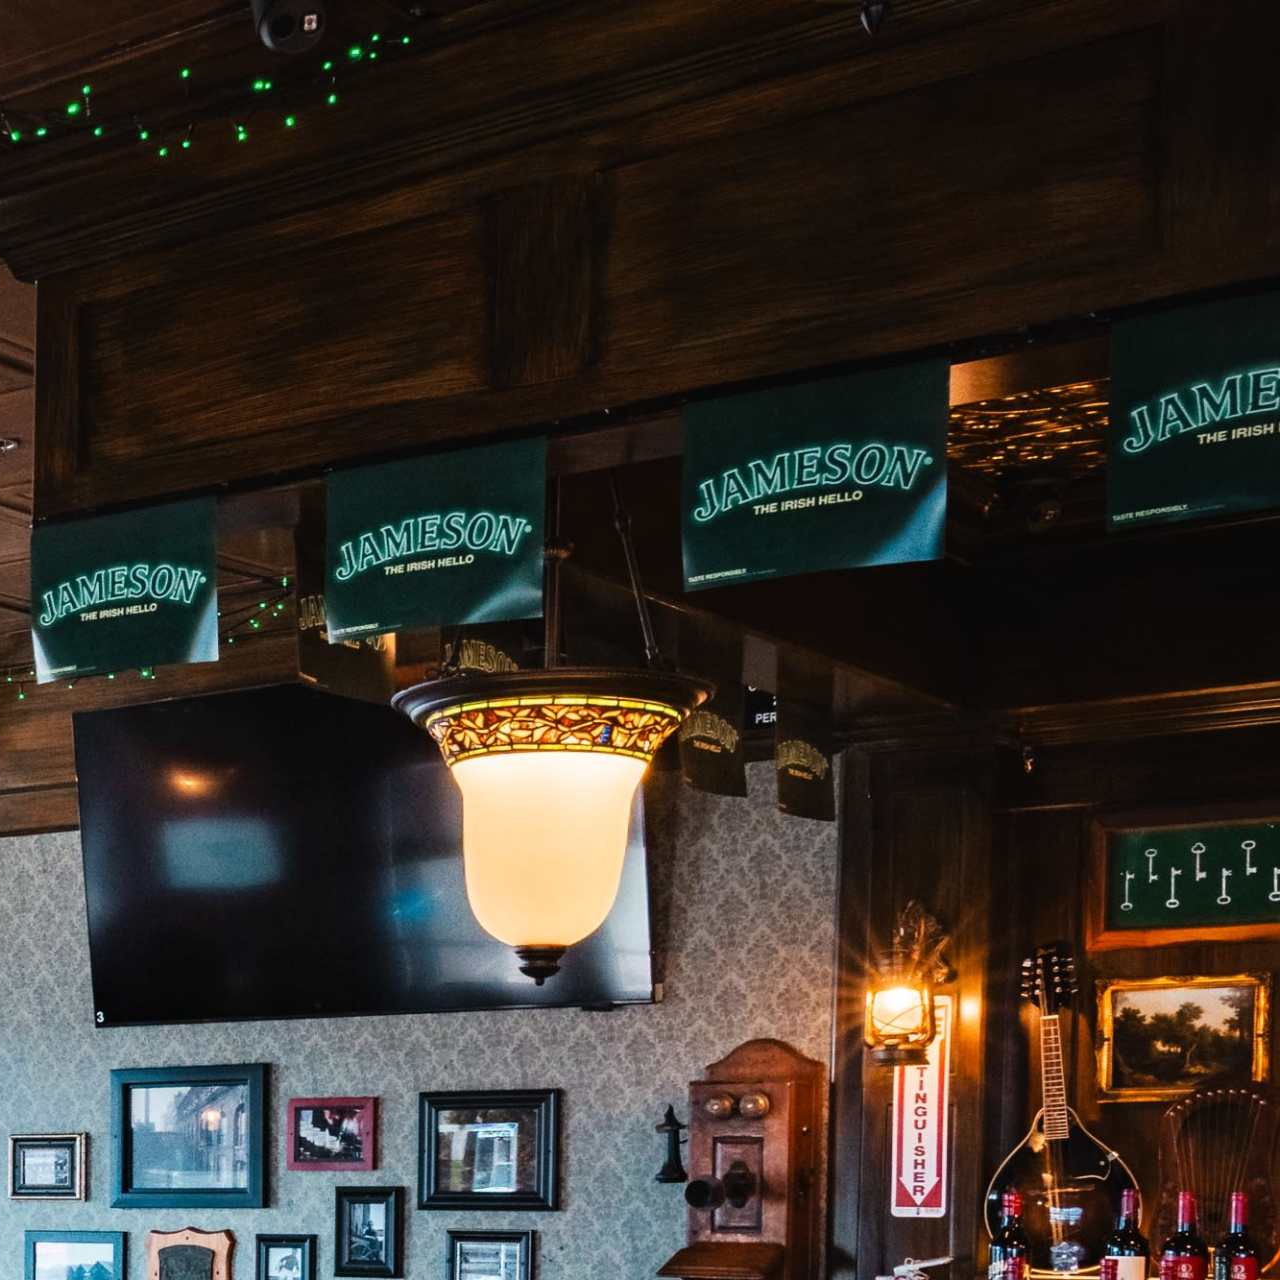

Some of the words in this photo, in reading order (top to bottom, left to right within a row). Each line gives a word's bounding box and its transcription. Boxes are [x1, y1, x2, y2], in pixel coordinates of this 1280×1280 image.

[1197, 431, 1228, 445] THE
[1232, 423, 1274, 440] IRISH
[694, 443, 926, 522] JAMESON
[753, 502, 778, 515] THE
[780, 496, 815, 511] IRISH
[818, 490, 863, 506] HELLO
[336, 512, 527, 580] JAMESON
[384, 564, 404, 576] THE
[406, 559, 435, 573] IRISH
[437, 554, 474, 568] HELLO
[40, 563, 202, 626] JAMESON
[80, 611, 98, 622] THE
[100, 607, 124, 619] IRISH
[126, 602, 158, 615] HELLO
[96, 1010, 105, 1023] 3
[913, 1067, 928, 1196] TINGUISHER
